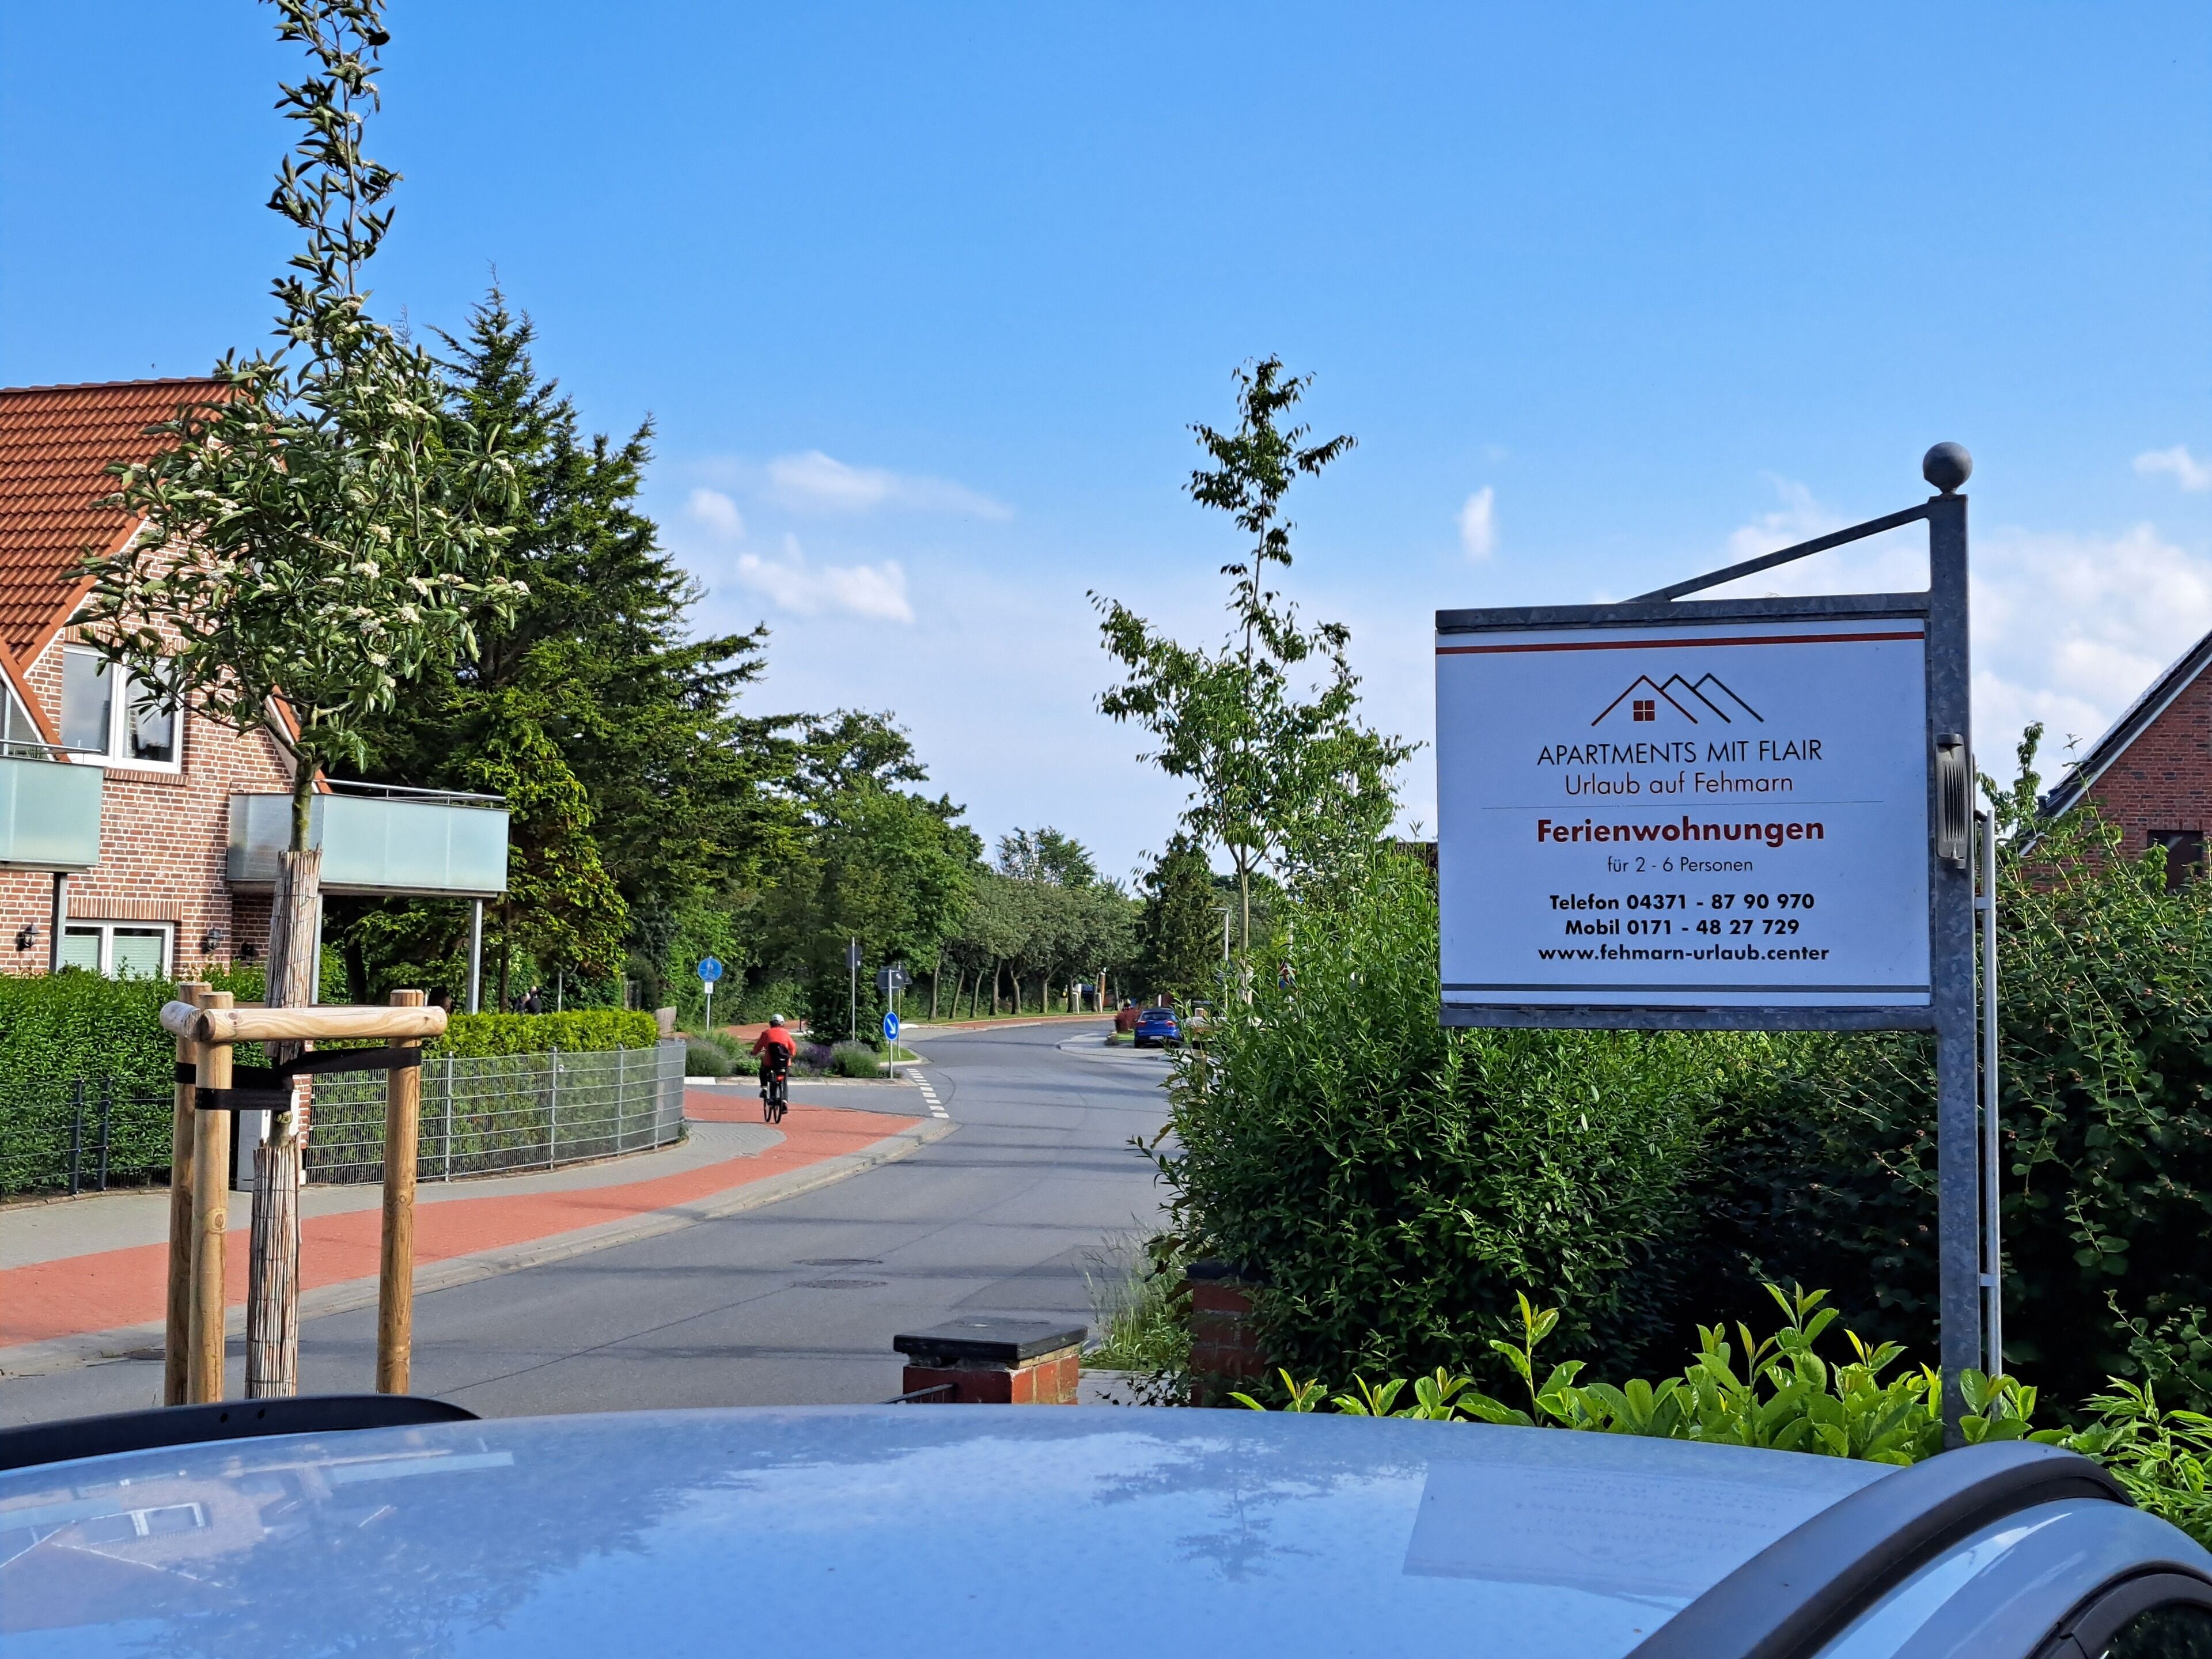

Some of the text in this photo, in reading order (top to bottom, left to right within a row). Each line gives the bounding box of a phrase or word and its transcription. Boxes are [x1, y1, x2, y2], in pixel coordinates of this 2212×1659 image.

[1537, 740, 1822, 765] APARTMENTS MIT FLAIR
[1566, 770, 1792, 795] Urlaub auf Fehmarn
[1538, 816, 1824, 847] Ferienwohnungen
[1608, 856, 1628, 872] für
[1636, 857, 1645, 872] 2
[1663, 857, 1673, 872] 6
[1681, 857, 1752, 872] Personen
[1550, 893, 1619, 910] Telefon
[1627, 895, 1685, 910] 04371
[1711, 894, 1735, 909] 87
[1744, 894, 1769, 909] 90
[1777, 893, 1814, 908] 970
[1566, 919, 1619, 935] Mobil
[1627, 920, 1671, 935] 0171
[1696, 919, 1721, 934] 48
[1730, 919, 1753, 934] 27
[1763, 919, 1799, 934] 729
[1538, 944, 1829, 960] www.fehmarn-urlaub.center
